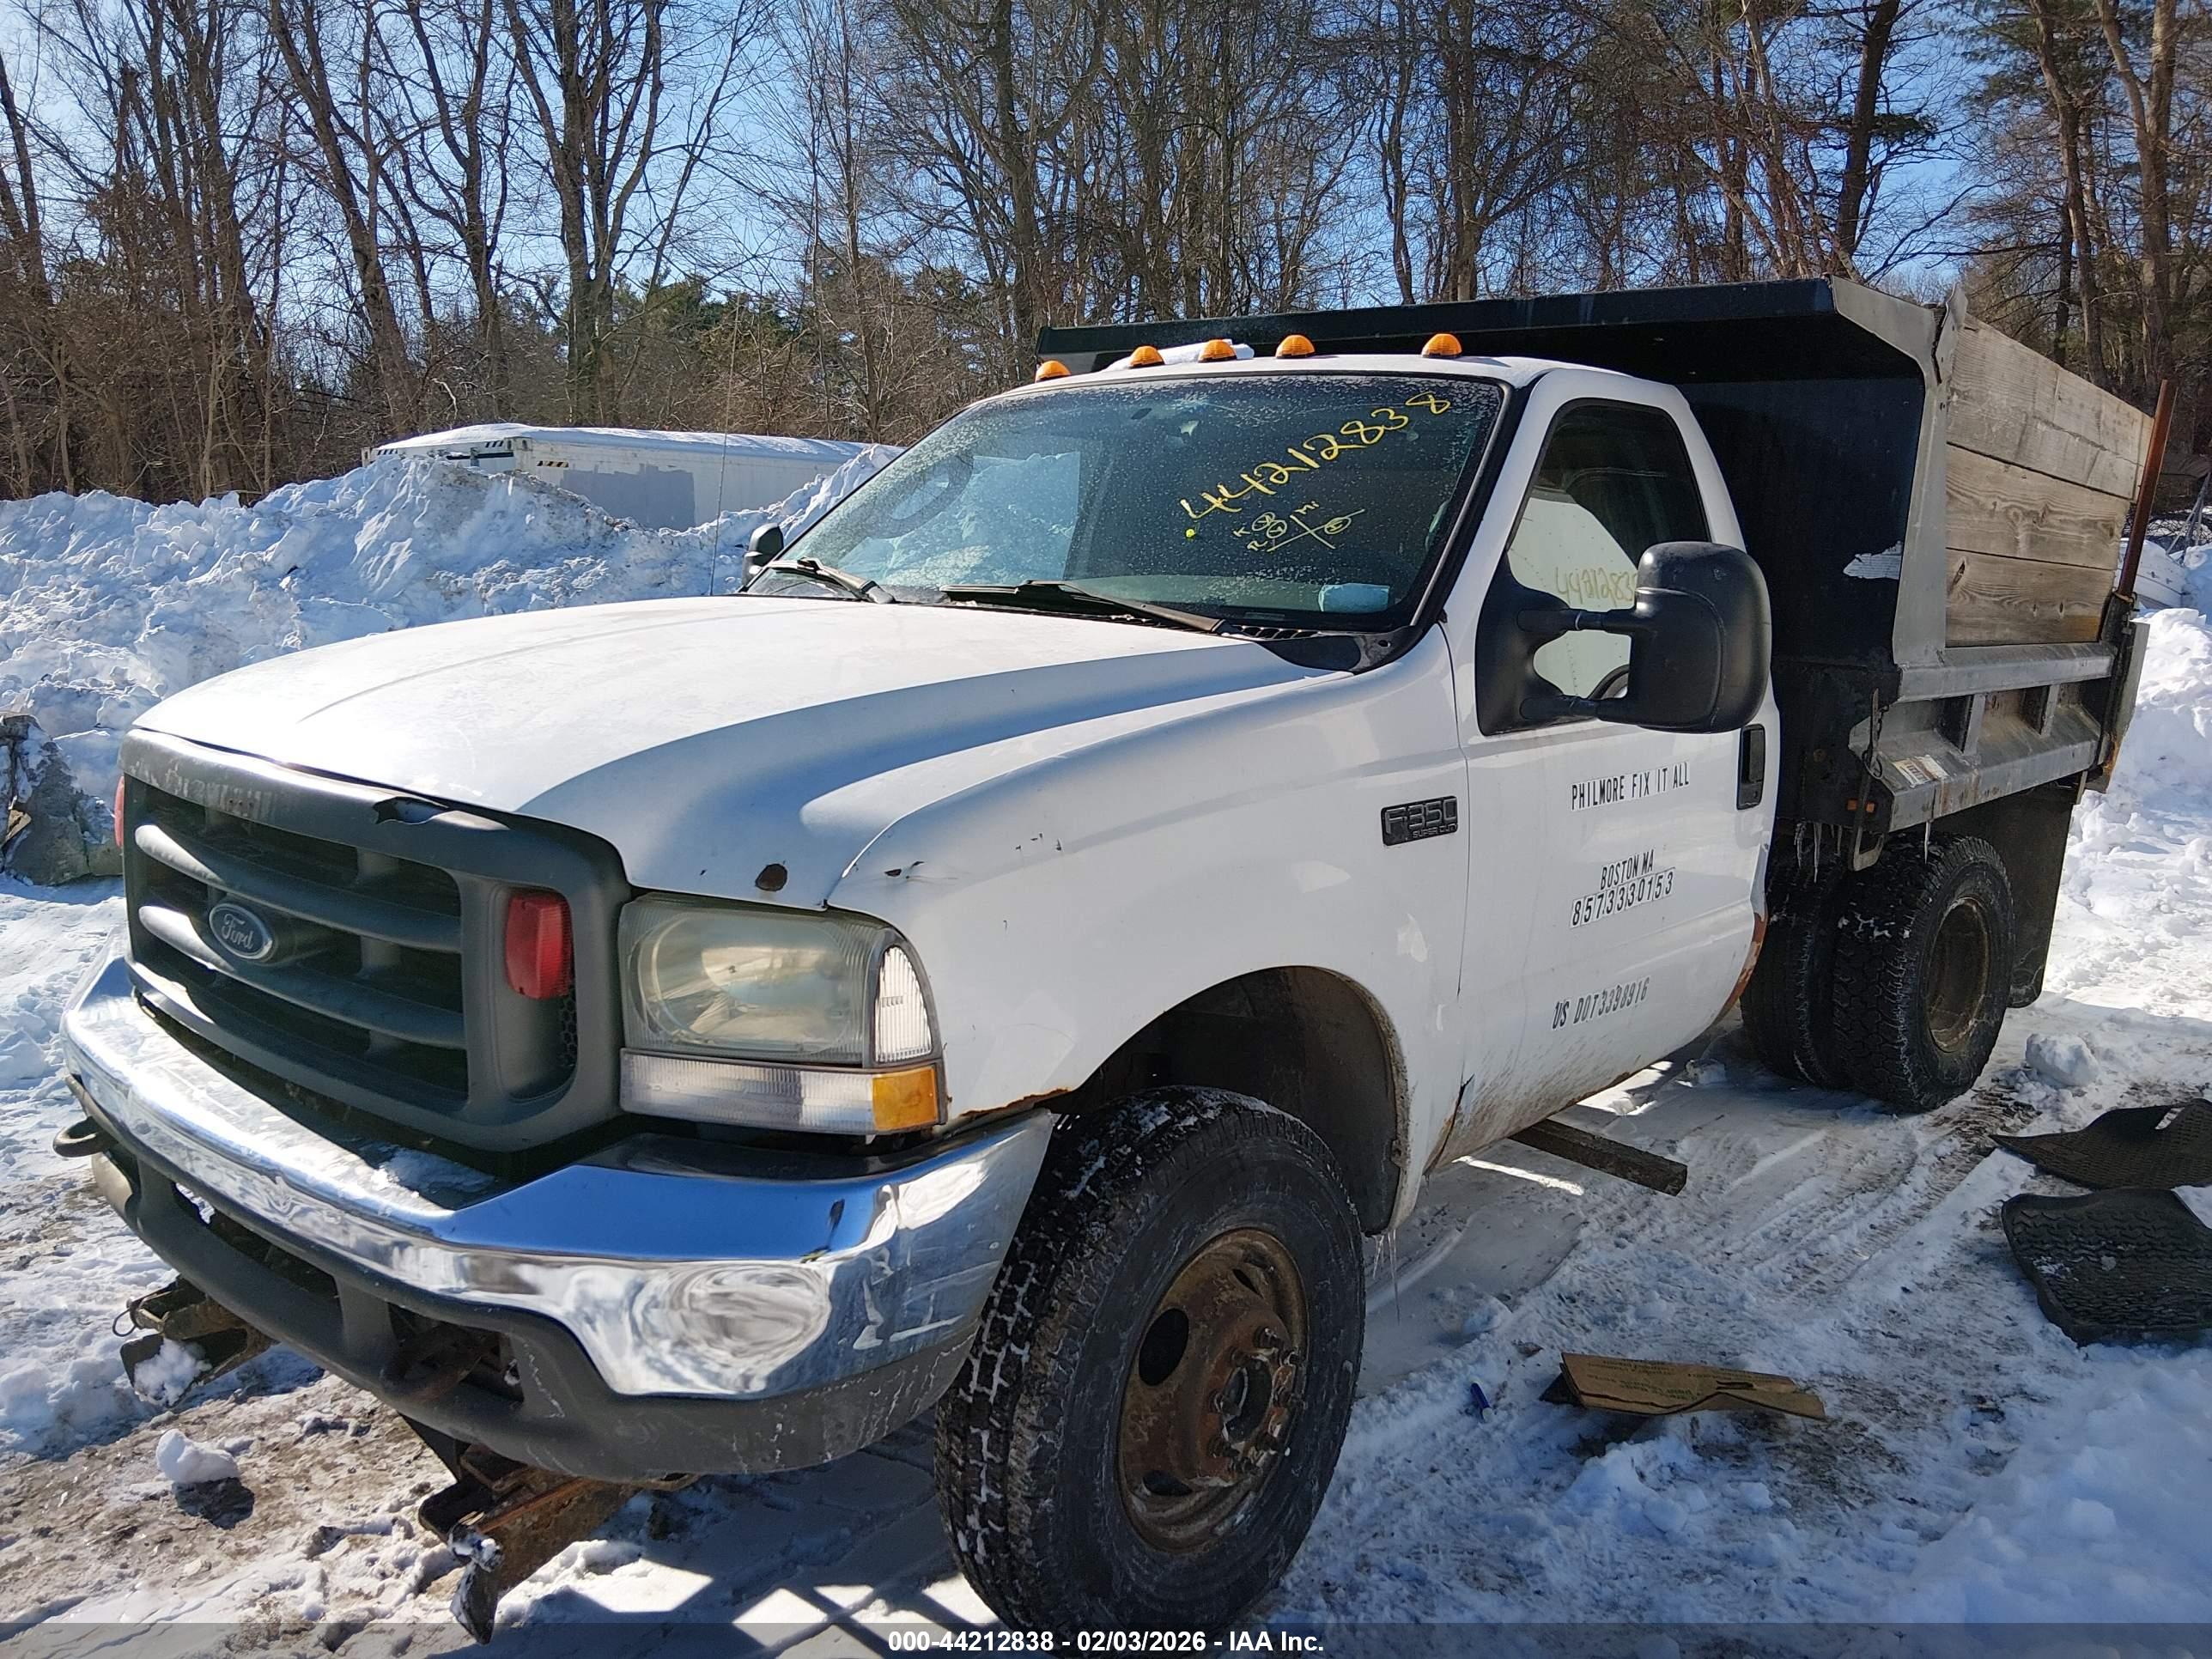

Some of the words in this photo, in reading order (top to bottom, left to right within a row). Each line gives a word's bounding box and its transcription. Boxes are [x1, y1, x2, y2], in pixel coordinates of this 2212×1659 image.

[1180, 391, 1451, 519] 44212838
[1571, 775, 1626, 811] PHILMORE
[1632, 771, 1650, 798] FIX
[1657, 768, 1668, 793] IT
[1672, 762, 1689, 789] ALL
[1600, 854, 1640, 890] BOSTON
[1641, 848, 1655, 875] MA
[221, 913, 254, 950] Ford
[1553, 1000, 1570, 1030] US
